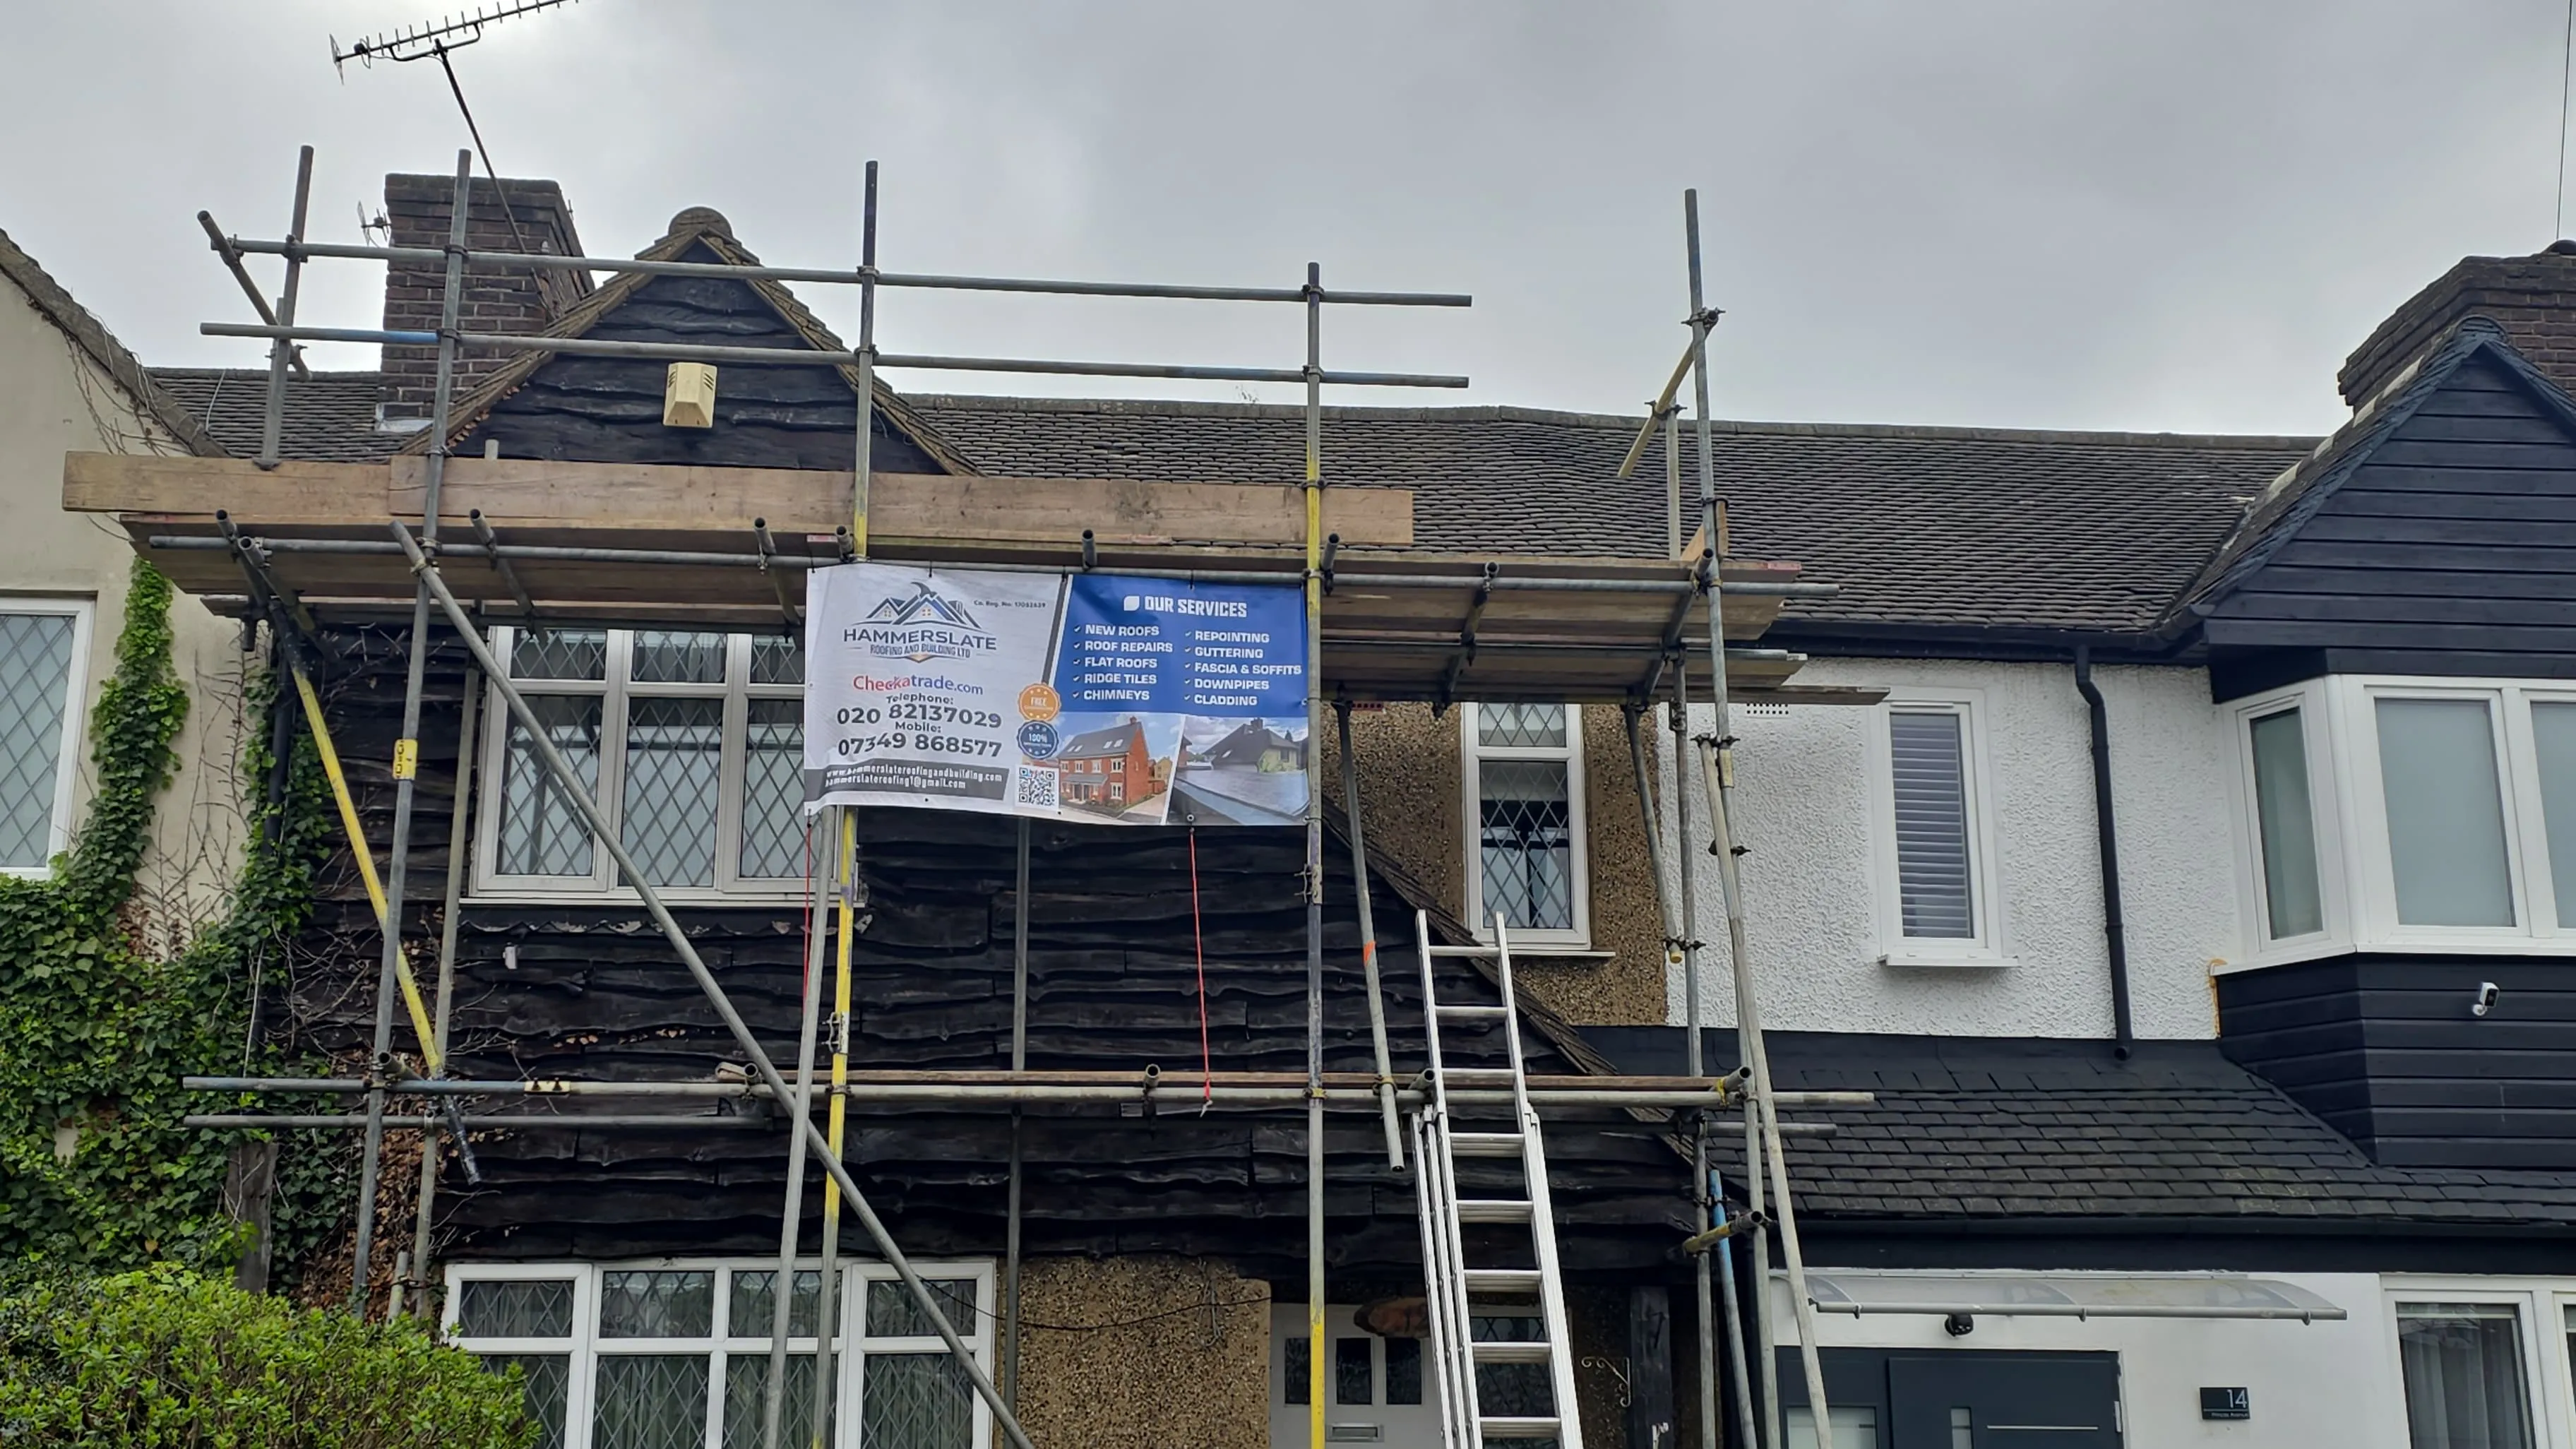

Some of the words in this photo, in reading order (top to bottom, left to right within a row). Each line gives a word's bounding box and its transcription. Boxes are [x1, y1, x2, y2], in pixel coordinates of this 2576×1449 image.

[1145, 596, 1174, 612] OUR
[1177, 599, 1247, 618] SERVICES
[1085, 624, 1116, 636] NEW
[1119, 626, 1159, 636] ROOFS
[844, 628, 996, 650] HAMMERSLATE
[1195, 631, 1270, 643] REPOINTING
[870, 644, 903, 655] ROOFING
[904, 644, 919, 655] AND
[921, 643, 956, 656] BUILDING
[957, 648, 970, 658] LTD
[1085, 640, 1118, 651] ROOF
[1121, 642, 1173, 652] REPAIRS
[1195, 647, 1263, 659] GUTTERING
[1085, 657, 1114, 667] FLAT
[1116, 657, 1157, 668] ROOFS
[1195, 662, 1238, 674] FASCIA
[1241, 664, 1249, 674] &
[1252, 664, 1302, 675] SOFFITS
[853, 674, 983, 695] Checkatrade.com
[1084, 673, 1121, 684] RIDGE
[1123, 674, 1157, 684] TILES
[1194, 679, 1269, 690] DOWNPIPES
[886, 692, 953, 705] Telephone:
[1083, 689, 1150, 700] CHIMNEYS
[1194, 694, 1258, 705] CLADDING
[837, 707, 881, 724] 020
[888, 703, 1002, 728] 82137029
[895, 721, 941, 733] Mobile:
[838, 732, 907, 756] 07349
[915, 734, 1002, 757] 868577
[2226, 1389, 2248, 1409] 14
